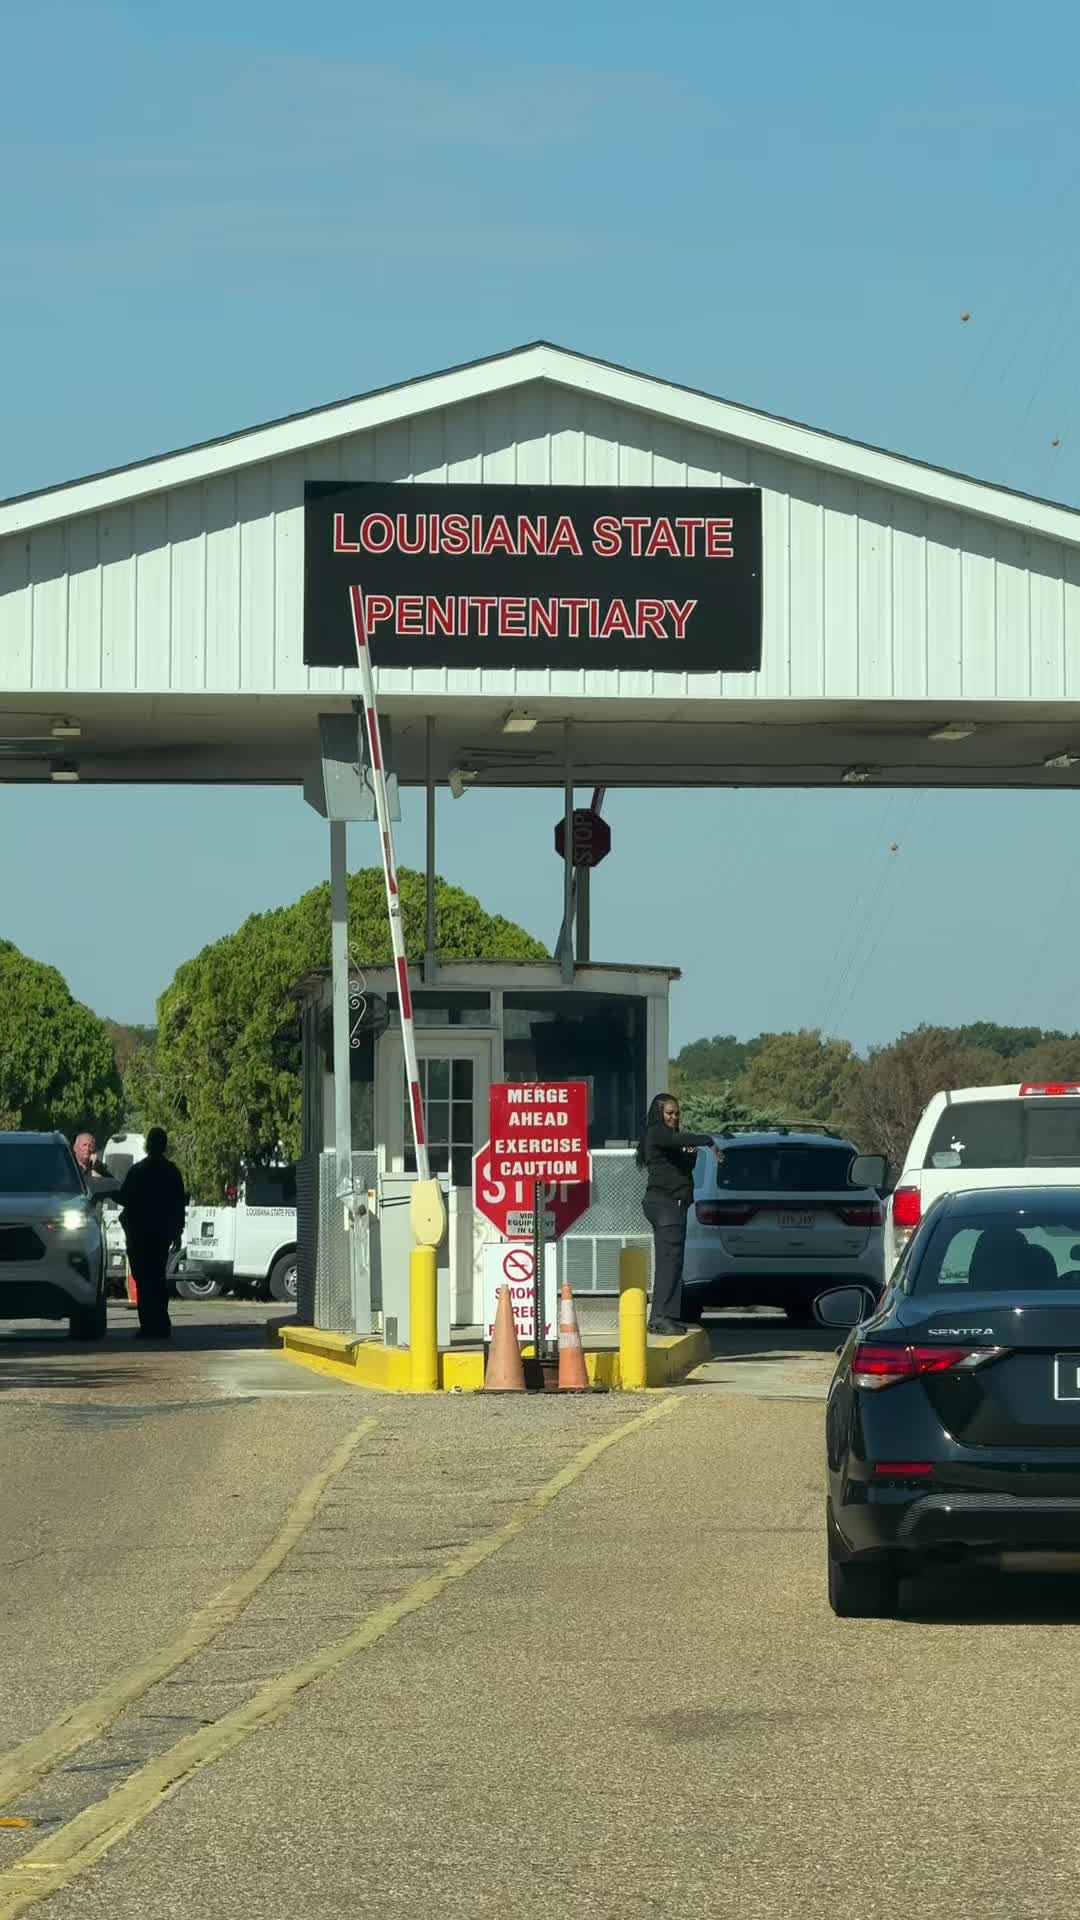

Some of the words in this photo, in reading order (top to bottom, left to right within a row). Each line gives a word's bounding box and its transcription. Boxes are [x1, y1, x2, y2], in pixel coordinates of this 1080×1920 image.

[333, 513, 583, 555] LOUISIANA
[592, 516, 735, 558] STATE
[365, 594, 698, 640] PENITENTIARY
[574, 814, 593, 864] STOP
[507, 1088, 569, 1103] MERGE
[508, 1111, 568, 1126] AHEAD
[495, 1138, 582, 1154] EXERCISE
[500, 1160, 578, 1176] CAUTION
[246, 1208, 270, 1217] LOUISIANA
[271, 1208, 284, 1217] STATE
[927, 1328, 995, 1336] SENTRA
